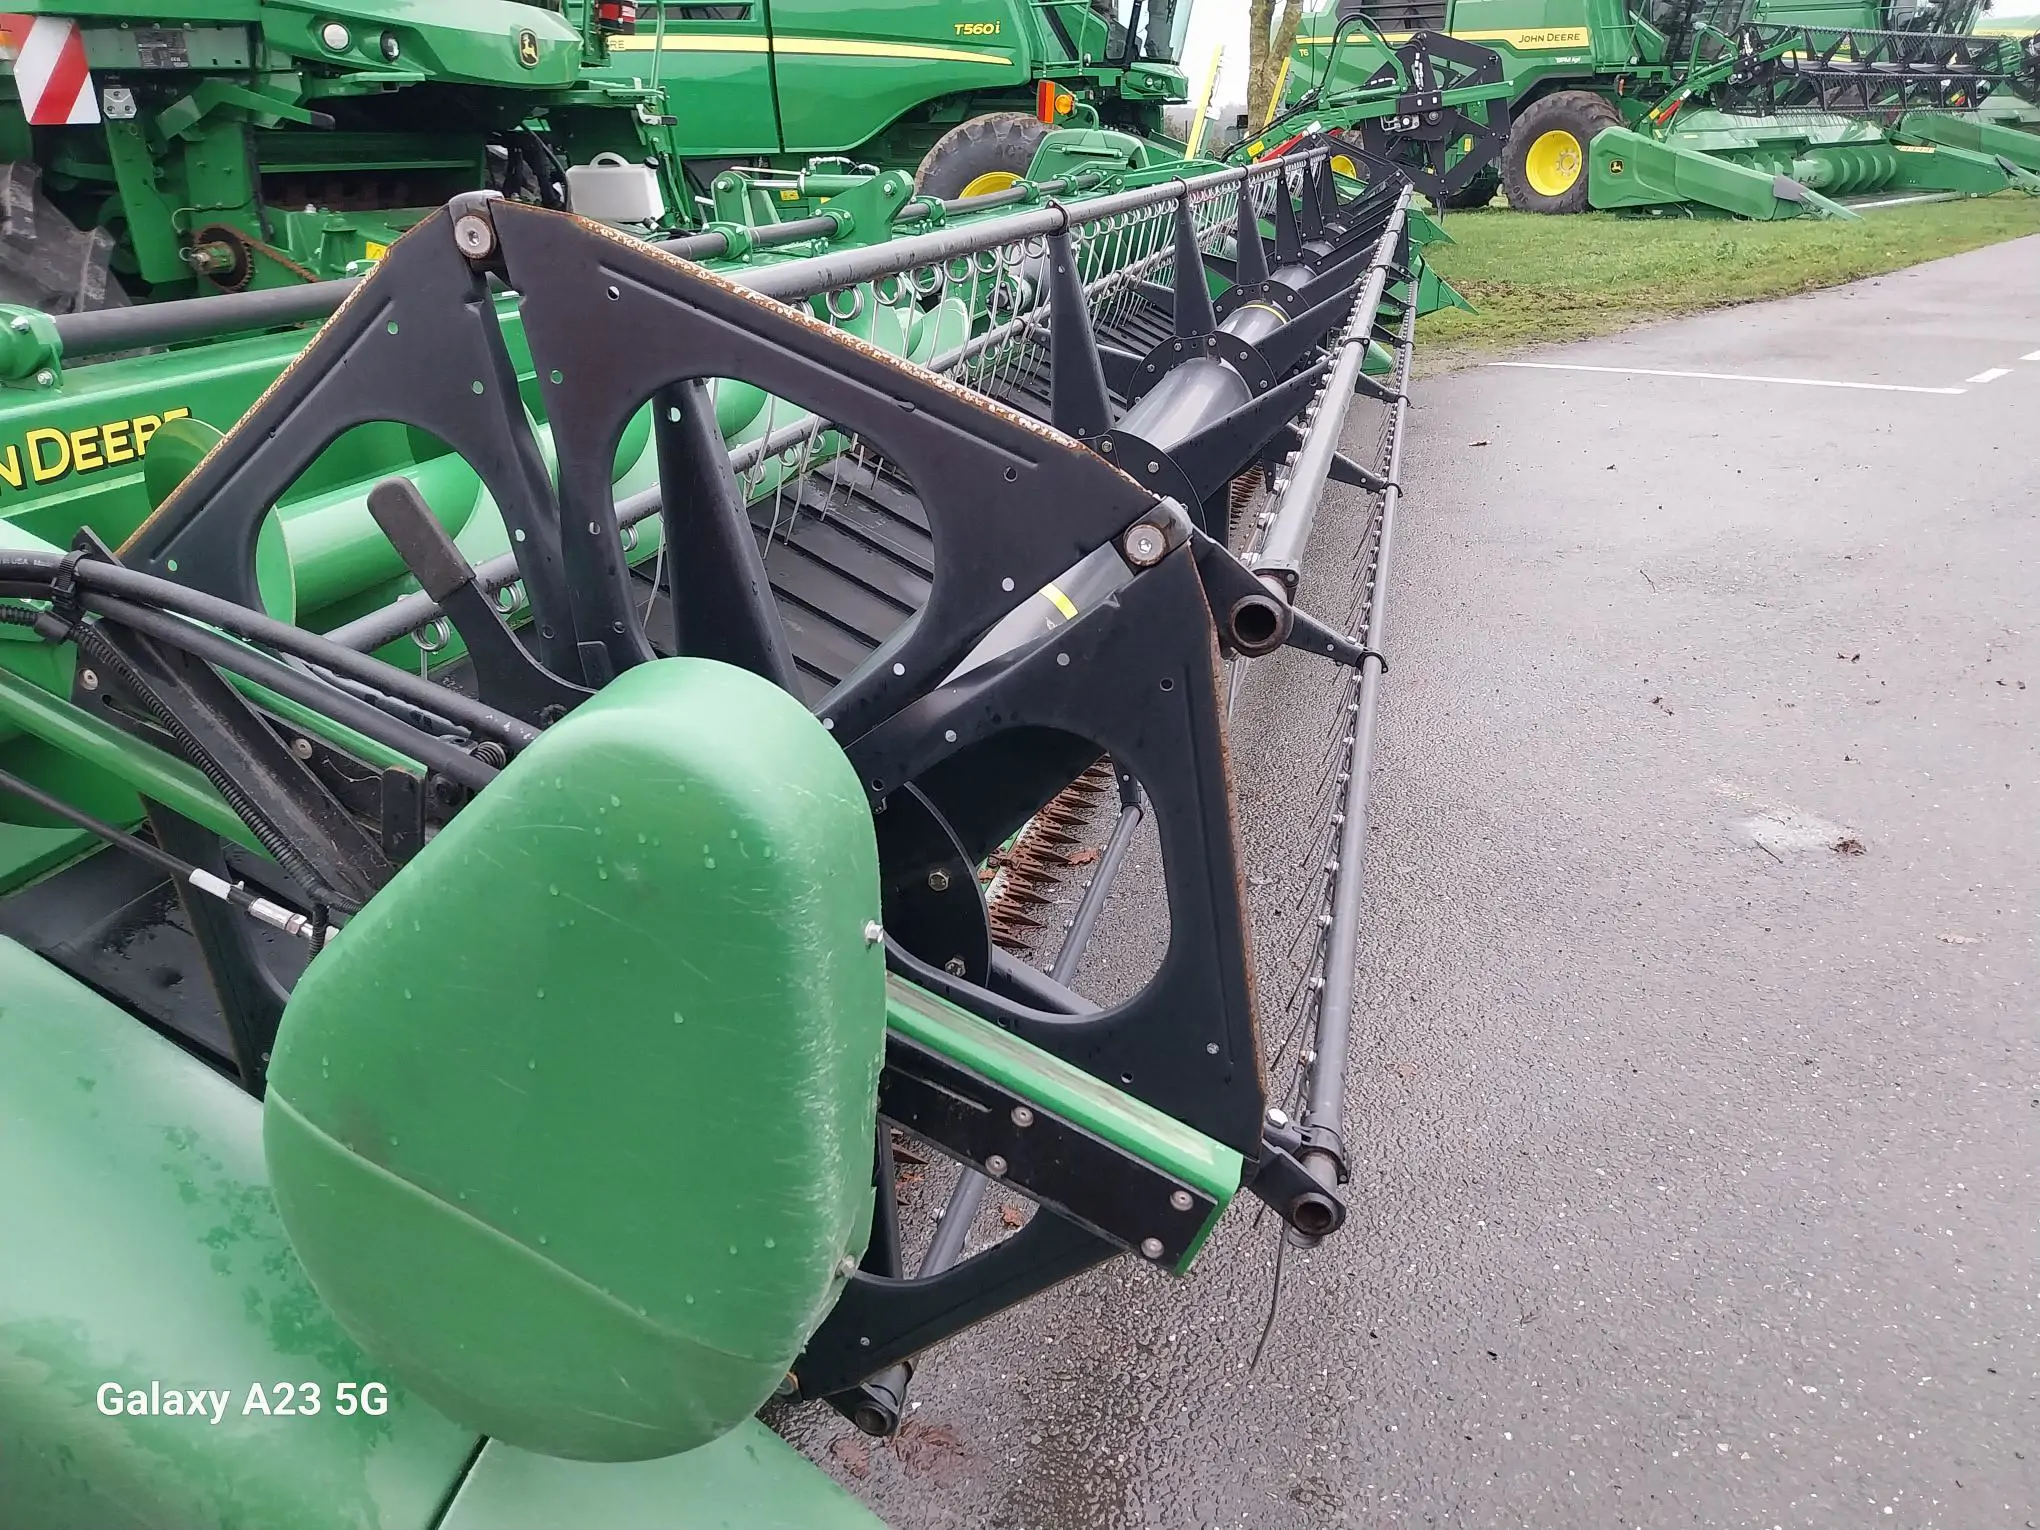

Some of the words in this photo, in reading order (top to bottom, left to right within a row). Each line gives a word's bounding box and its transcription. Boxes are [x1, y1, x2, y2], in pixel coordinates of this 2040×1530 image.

[953, 20, 1000, 36] T560i
[1518, 34, 1545, 44] JOHN
[1546, 32, 1581, 42] DEERE
[26, 407, 190, 483] DEER
